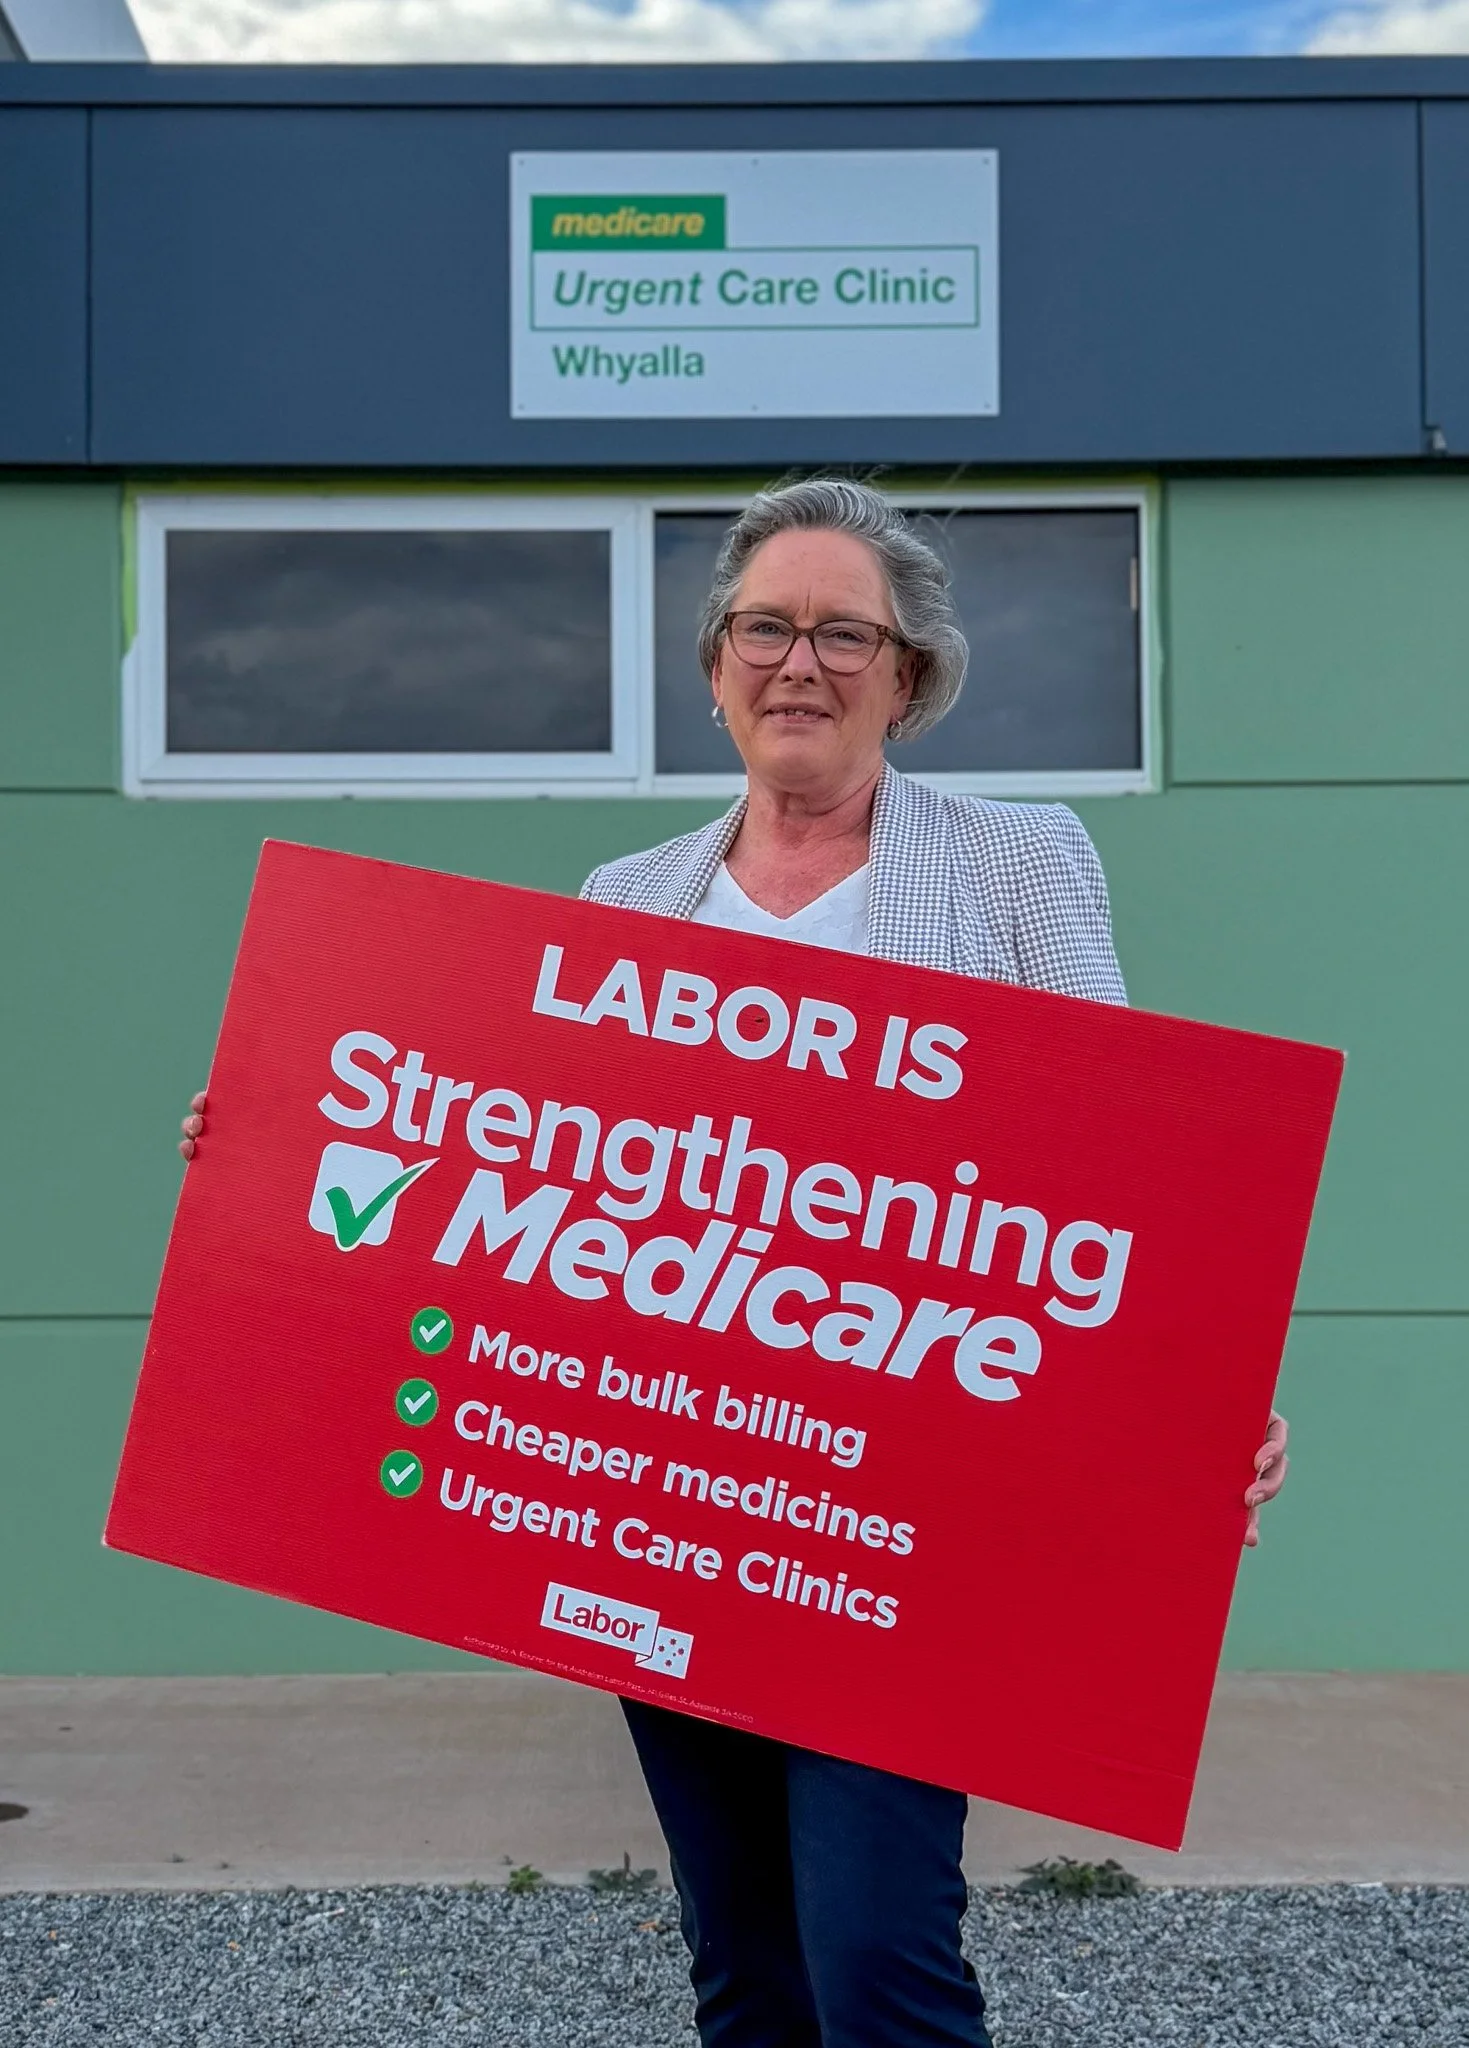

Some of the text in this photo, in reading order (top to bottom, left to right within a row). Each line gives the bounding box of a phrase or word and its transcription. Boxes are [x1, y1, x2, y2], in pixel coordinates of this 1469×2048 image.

[552, 206, 705, 237] medicare
[553, 267, 956, 315] Urgent Care Clinic
[552, 345, 705, 385] Whyalla
[531, 943, 969, 1100] LABOR IS
[317, 1030, 1134, 1328] Strengthening
[432, 1168, 1042, 1402] Medicare
[468, 1324, 867, 1469] More bulk billing
[439, 1467, 900, 1629] Urgent Care Clinics
[454, 1400, 916, 1556] Cheaper medicines
[552, 1592, 646, 1643] Labor
